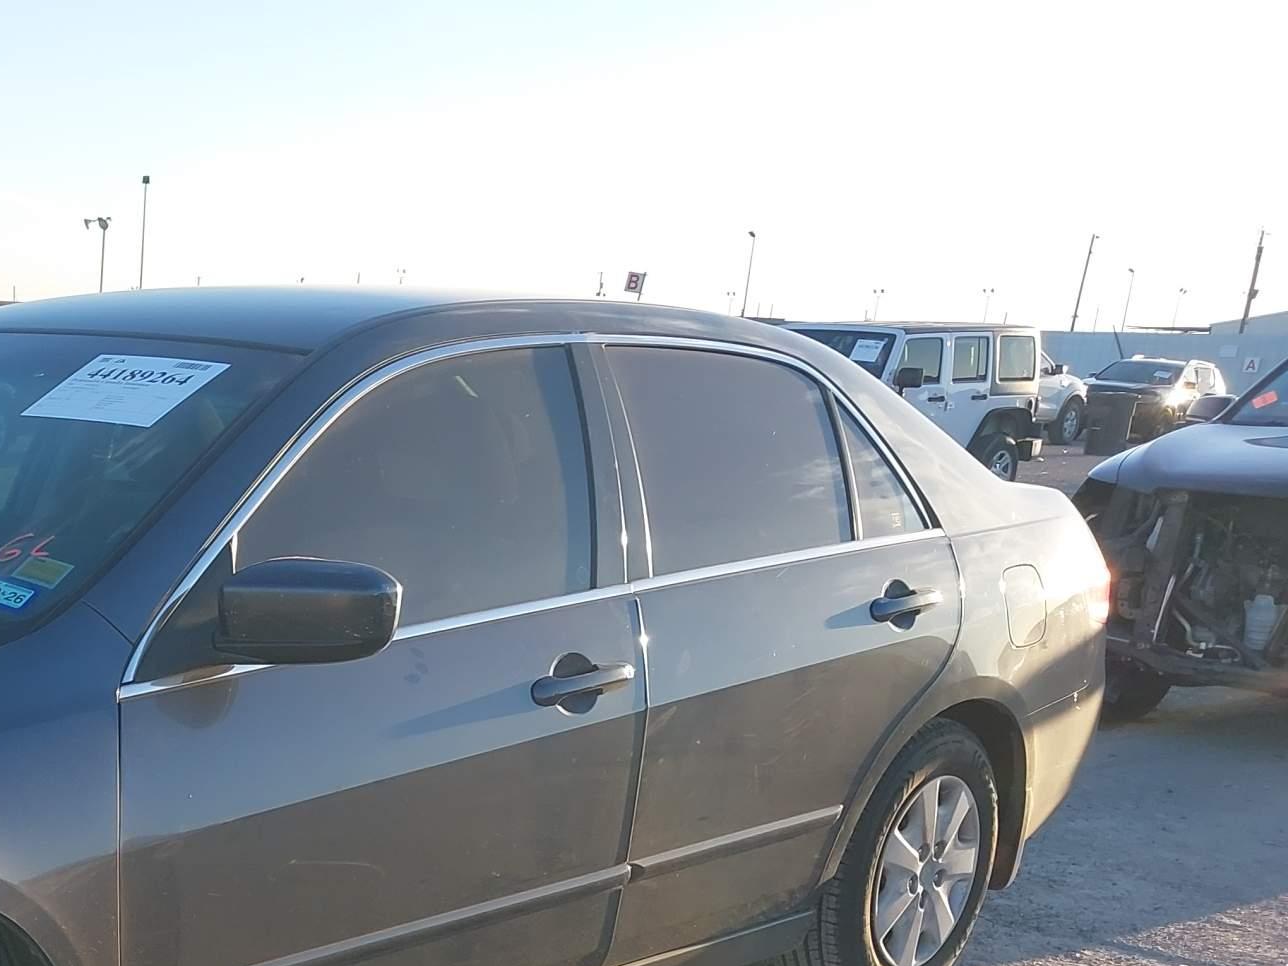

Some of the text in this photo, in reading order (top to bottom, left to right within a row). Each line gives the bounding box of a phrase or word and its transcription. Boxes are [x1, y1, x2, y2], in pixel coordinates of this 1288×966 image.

[627, 274, 640, 290] B
[1245, 359, 1256, 371] A
[87, 367, 196, 387] 44189264
